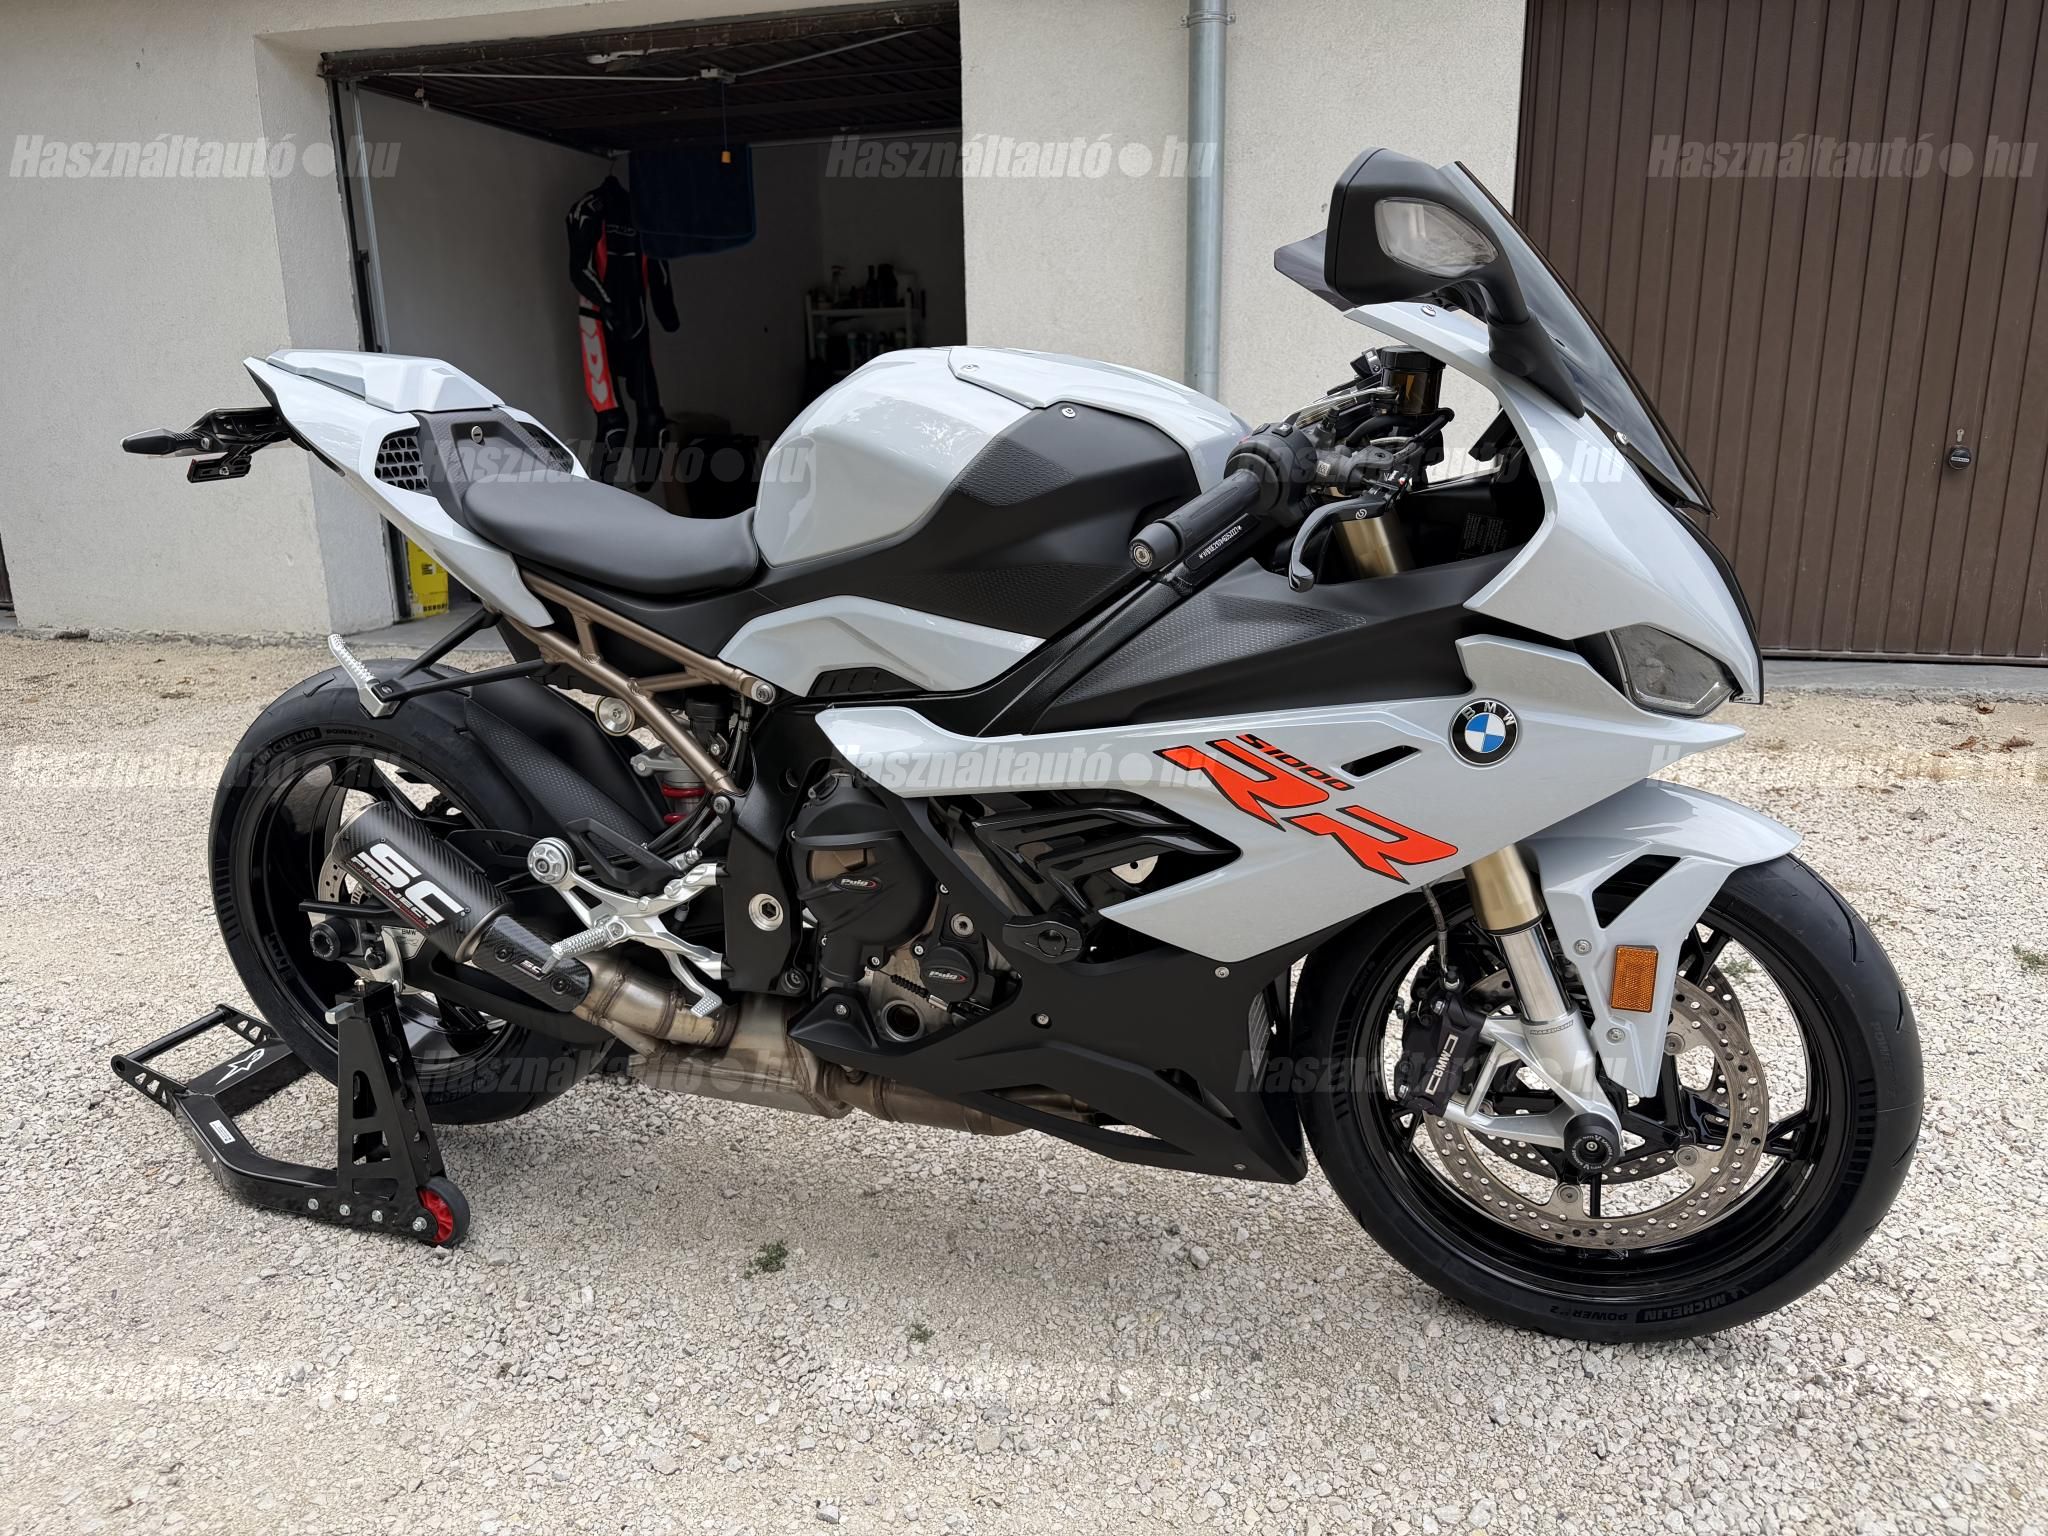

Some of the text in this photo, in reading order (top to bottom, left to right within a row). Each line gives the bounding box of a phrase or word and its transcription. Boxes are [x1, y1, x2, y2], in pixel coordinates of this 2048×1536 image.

[258, 729, 317, 765] MICHELIN
[350, 855, 437, 926] PROJECT
[840, 878, 870, 888] Puig
[401, 928, 417, 937] BMW
[928, 970, 959, 981] Puig
[1434, 1051, 1452, 1078] BMW
[1572, 1310, 1628, 1322] POWER
[1643, 1294, 1727, 1322] MICHELIN
